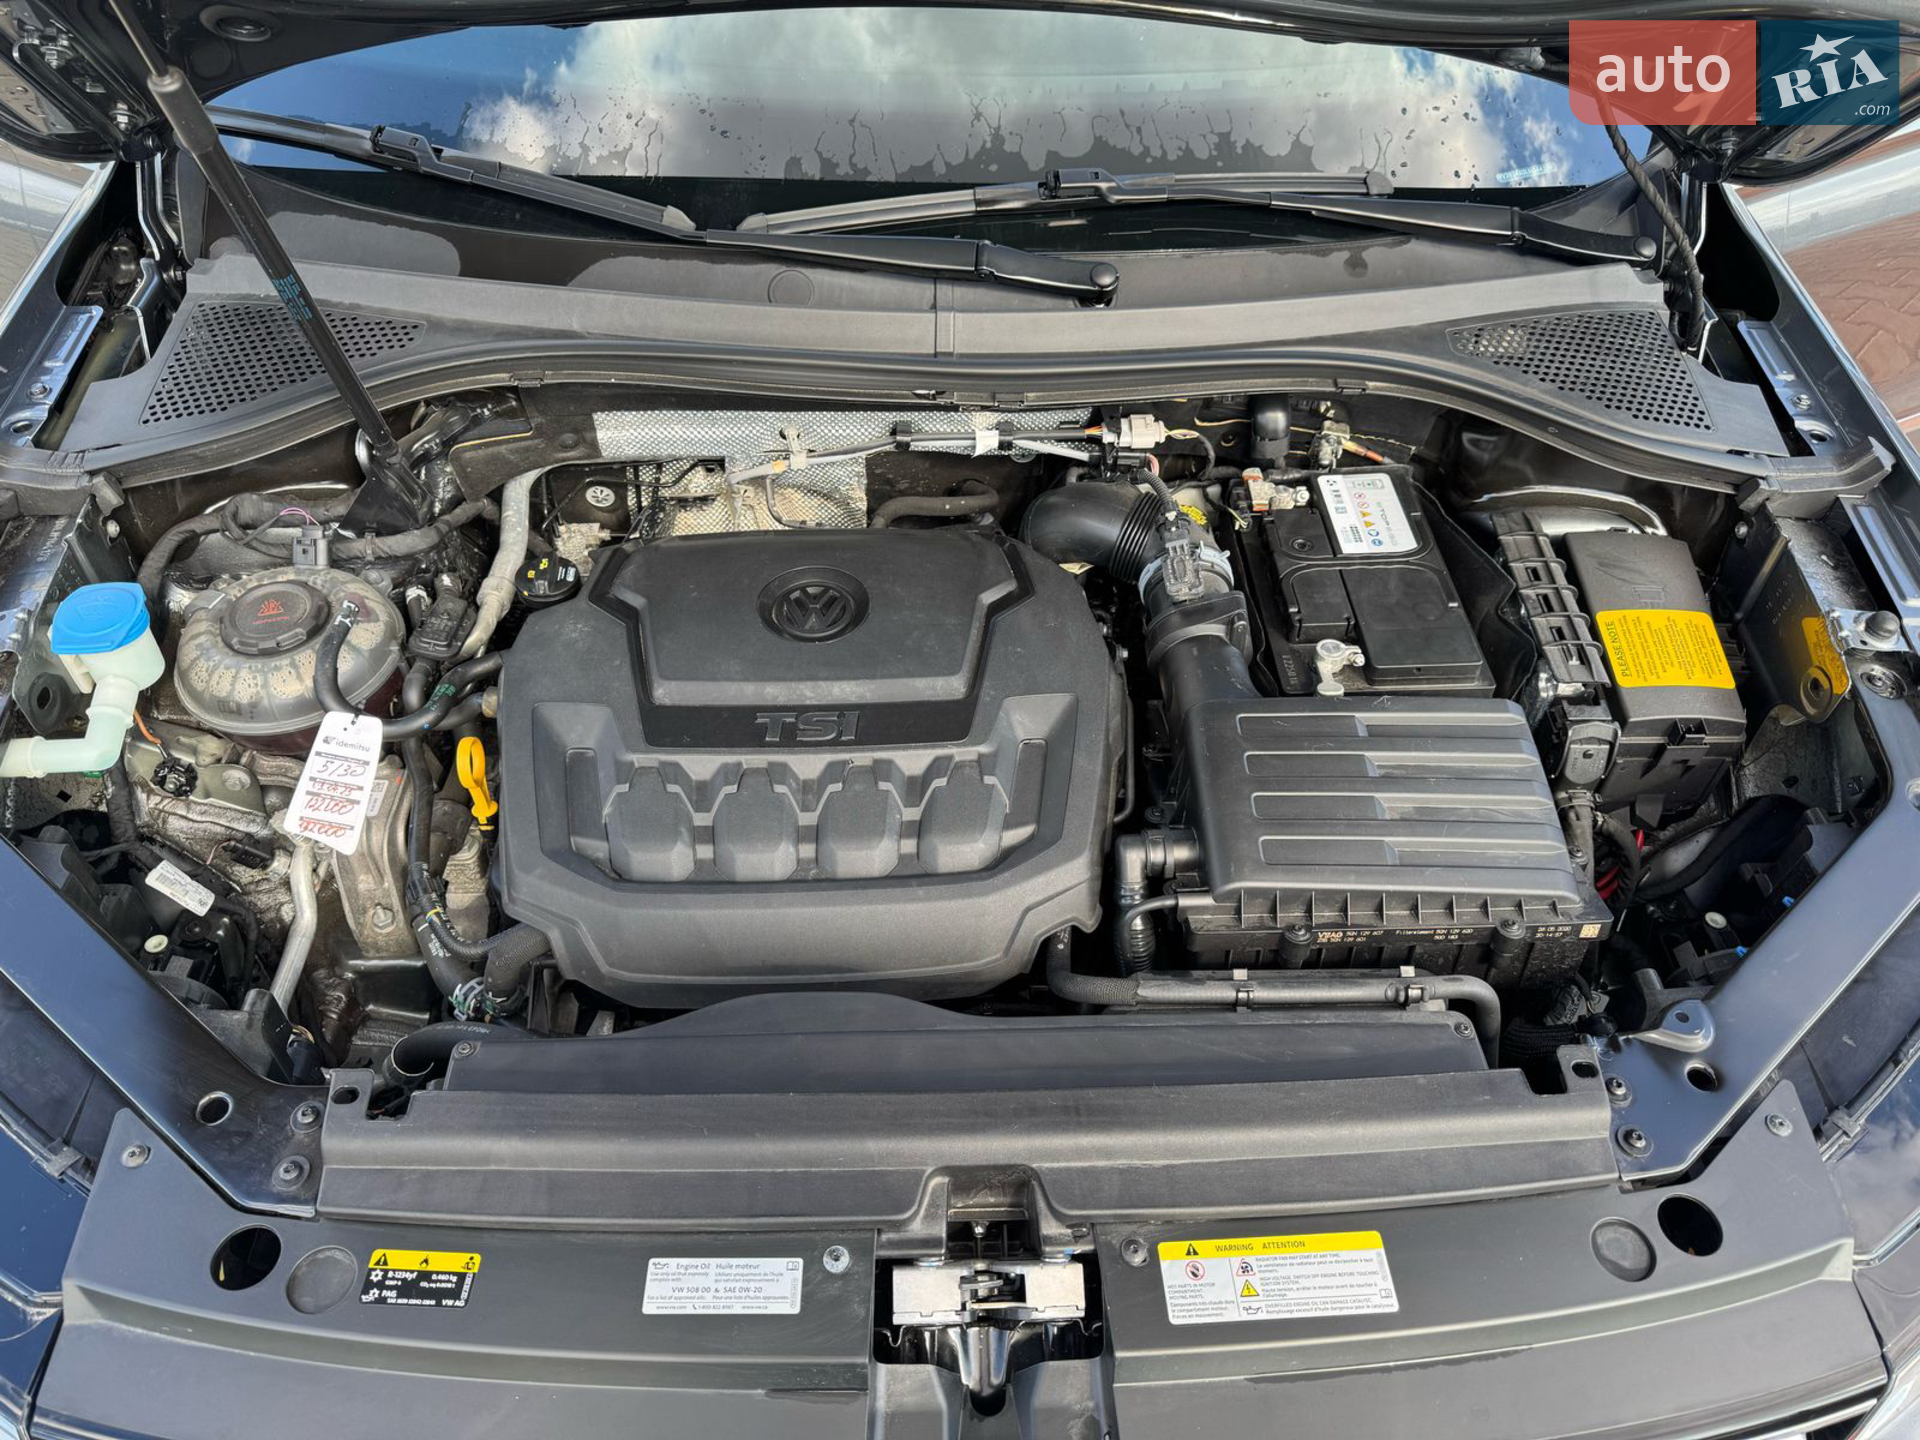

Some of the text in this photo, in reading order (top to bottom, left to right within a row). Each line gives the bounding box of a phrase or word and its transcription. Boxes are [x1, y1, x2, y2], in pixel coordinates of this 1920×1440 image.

[1605, 620, 1630, 678] PLEASE NOTE
[755, 711, 860, 741] TSI
[336, 739, 370, 752] idemitsu
[1215, 1240, 1306, 1252] WARNING ATTENTION
[677, 1263, 699, 1271] Engine
[381, 1289, 398, 1298] PAG
[441, 1298, 455, 1306] VW
